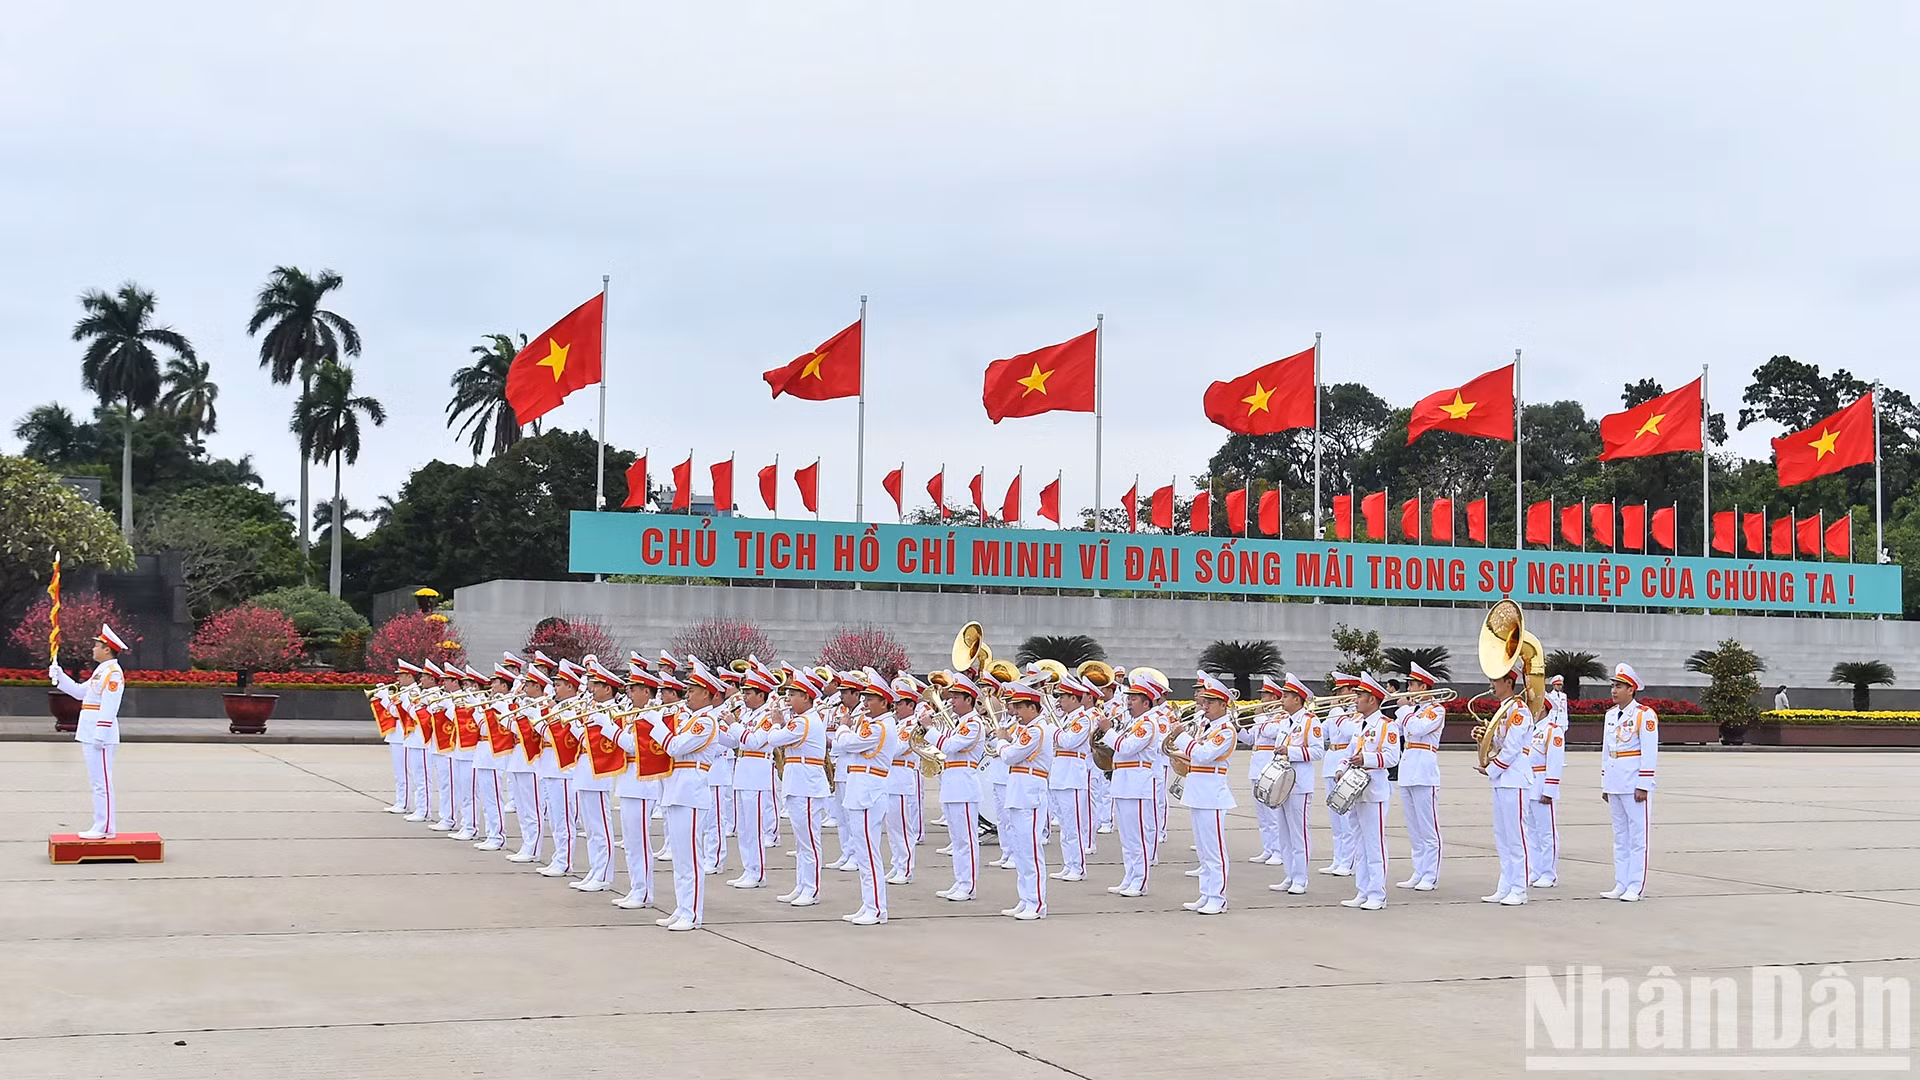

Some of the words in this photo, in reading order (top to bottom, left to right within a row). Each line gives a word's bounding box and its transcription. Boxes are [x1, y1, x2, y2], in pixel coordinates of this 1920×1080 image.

[640, 518, 717, 567] CHỦ
[734, 530, 817, 576] TỊCH
[834, 524, 881, 574] HỒ
[897, 531, 956, 575] CHÍ
[972, 540, 1062, 579] MINH
[1079, 539, 1110, 580] VĨ
[1124, 547, 1180, 589] ĐẠI
[1194, 539, 1282, 586] SỐNG
[1296, 548, 1354, 588] MÃI
[1367, 555, 1466, 592] TRONG
[1478, 557, 1518, 600] SỰ
[1527, 559, 1632, 604] NGHIỆP
[1641, 557, 1696, 600] CỦA
[1706, 564, 1795, 603] CHÚNG
[1805, 572, 1838, 605] TA
[1848, 574, 1856, 605] !
